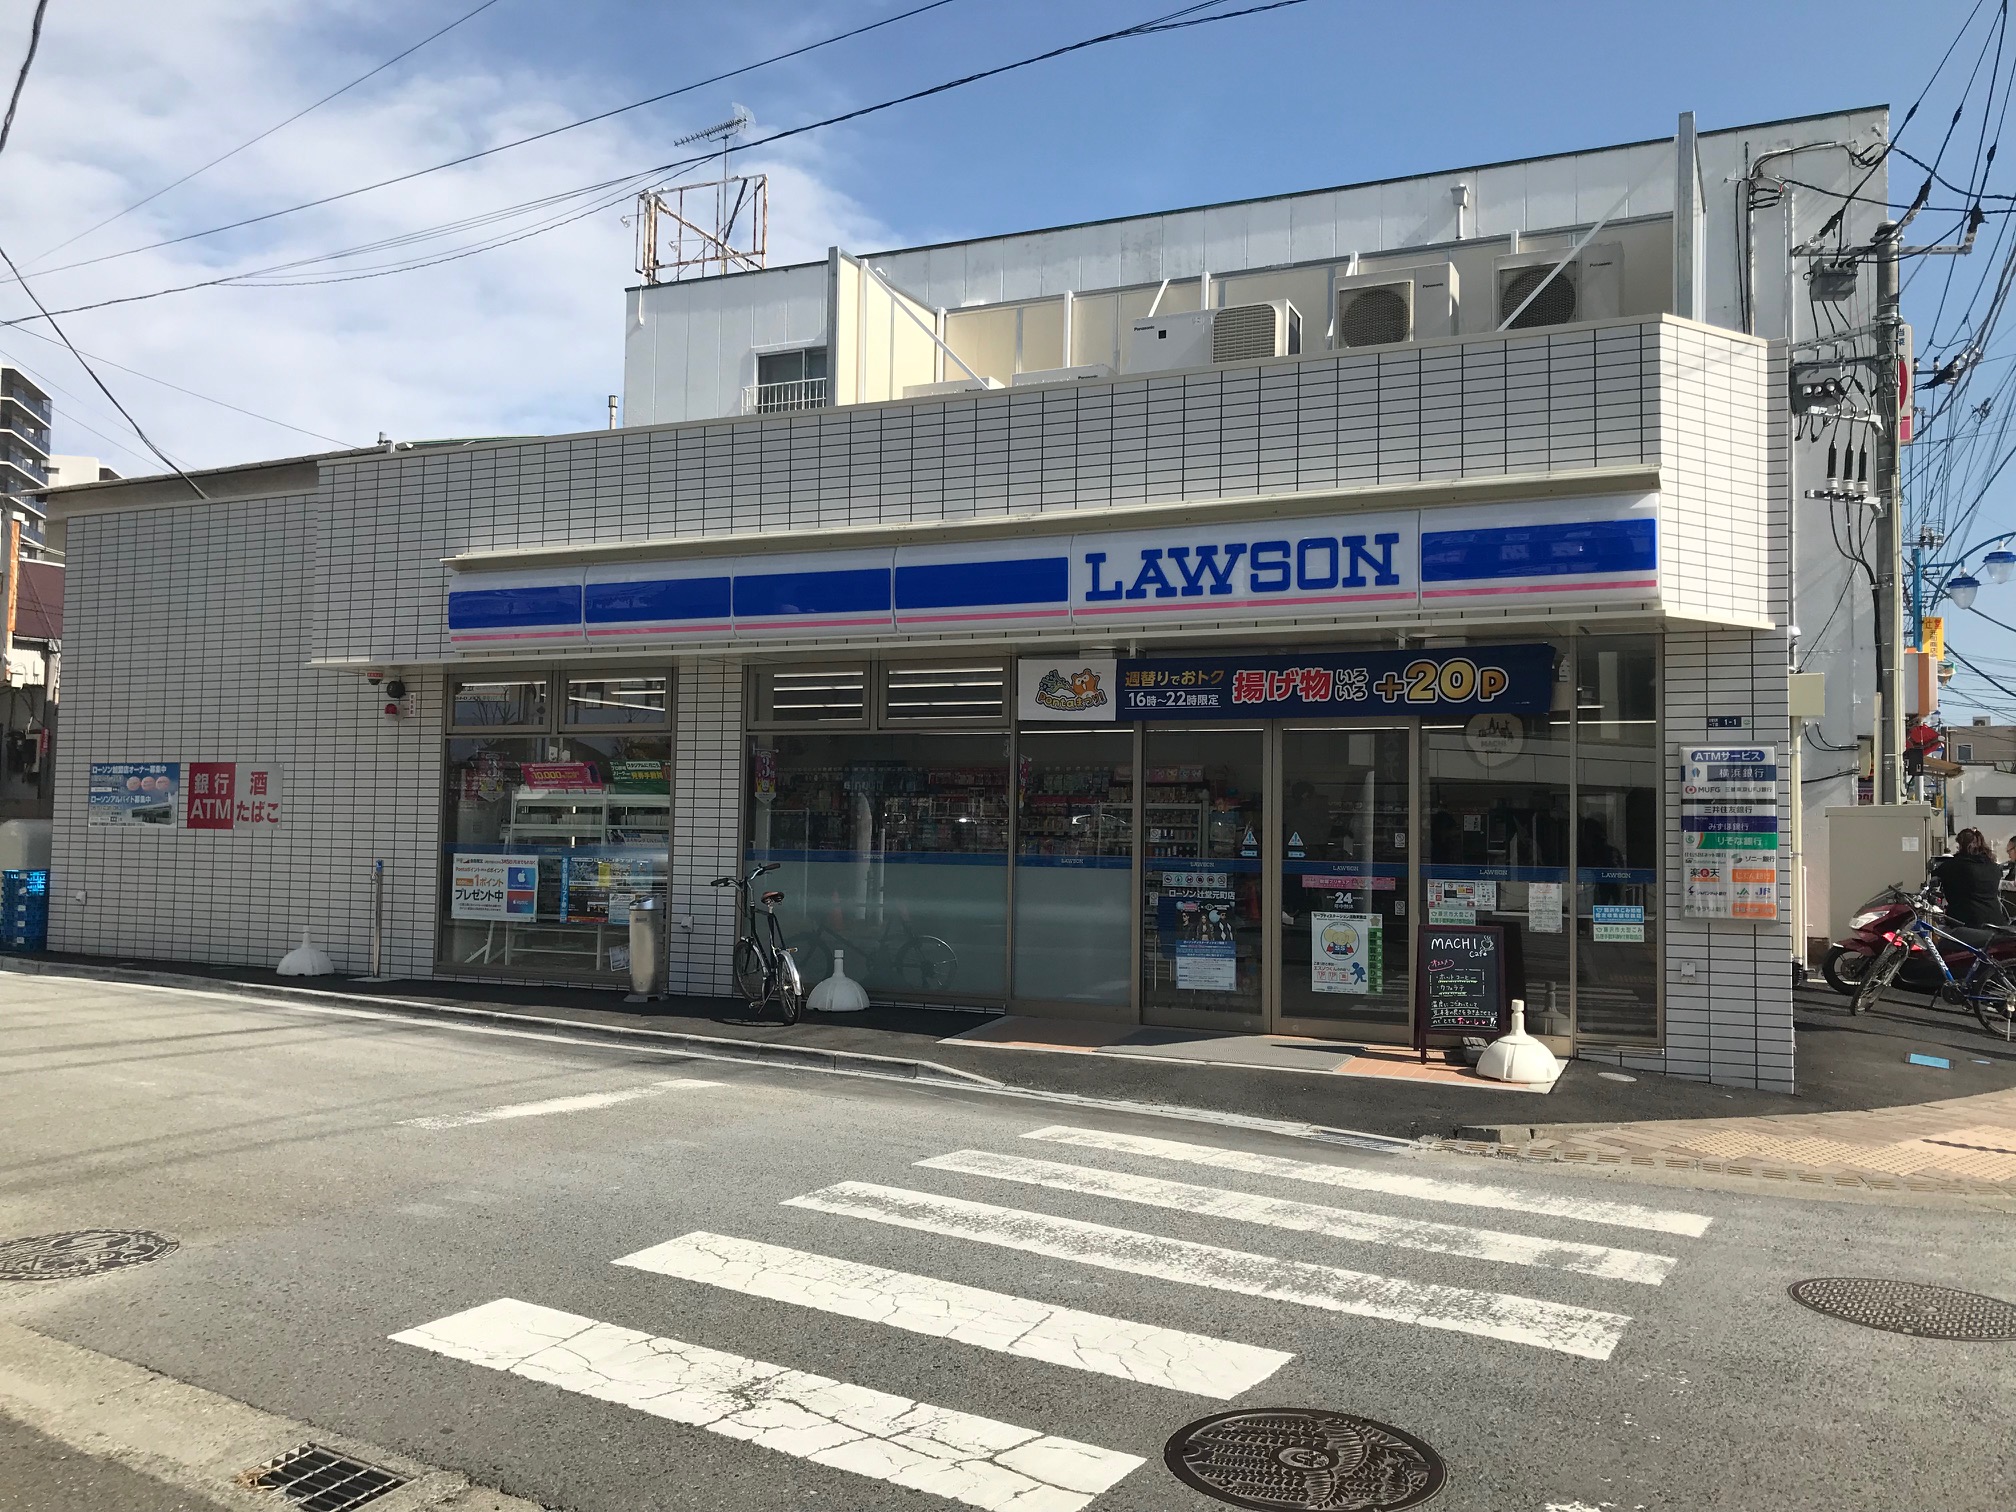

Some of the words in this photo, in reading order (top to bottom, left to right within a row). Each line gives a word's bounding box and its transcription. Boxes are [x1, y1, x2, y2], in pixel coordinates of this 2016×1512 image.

[1422, 282, 1444, 290] Panasonic
[1133, 325, 1155, 333] Panasonic
[1085, 532, 1400, 602] LAWSON
[1125, 670, 1225, 687] 週替りでおトク
[1336, 669, 1369, 685] いろ
[1233, 667, 1333, 703] 揚げ物
[1336, 685, 1369, 701] いろ
[1724, 718, 1737, 726] 1-1
[1695, 752, 1761, 761] ATMサービス
[1719, 768, 1764, 778] 横浜銀行
[194, 773, 229, 794] 銀行
[249, 771, 268, 795] 酒
[190, 799, 231, 819] ATM
[236, 801, 279, 823] たばこ
[1708, 823, 1749, 831] みずほ銀行
[1717, 836, 1762, 846] りそな銀行
[1745, 855, 1775, 863] ソニー銀行
[474, 874, 504, 887] 1ポイント
[455, 887, 504, 902] プレゼント中
[1169, 889, 1235, 900] ローソン辻堂元町店
[1335, 891, 1353, 904] 24
[1431, 937, 1477, 950] MACHI
